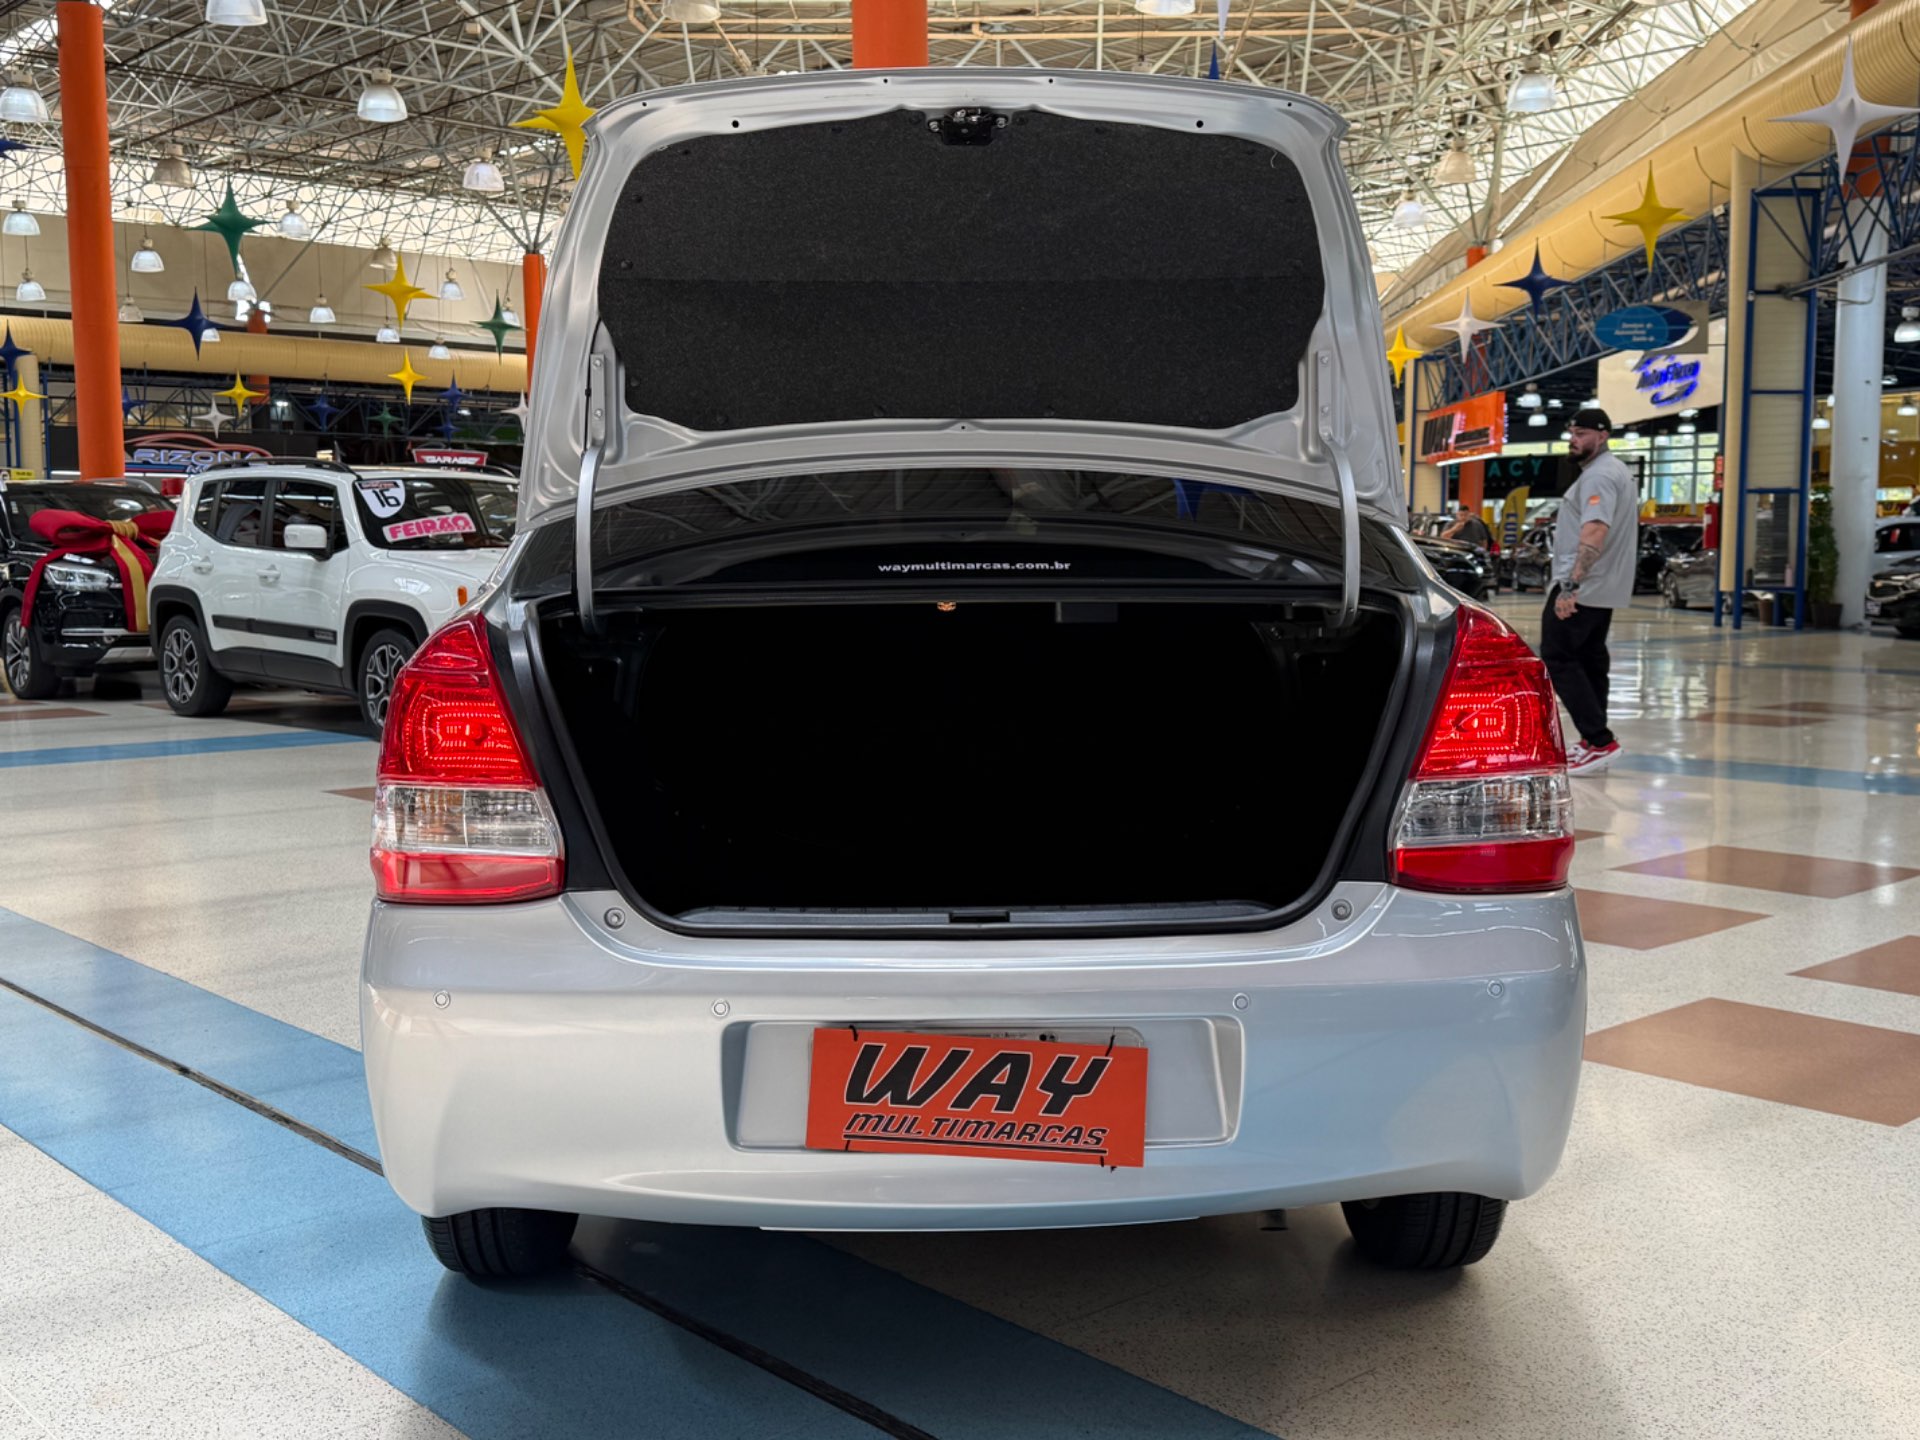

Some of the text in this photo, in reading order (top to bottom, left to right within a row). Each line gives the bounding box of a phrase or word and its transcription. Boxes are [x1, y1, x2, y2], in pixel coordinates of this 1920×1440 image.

[128, 449, 268, 466] RIZONA
[422, 455, 481, 466] GARAGE
[372, 488, 401, 508] 16
[388, 514, 473, 541] FEIRÃO
[877, 560, 1072, 574] waymultimarcas.com.br
[844, 1042, 1113, 1117] WAY
[843, 1112, 1109, 1146] MULTIMARCAS
